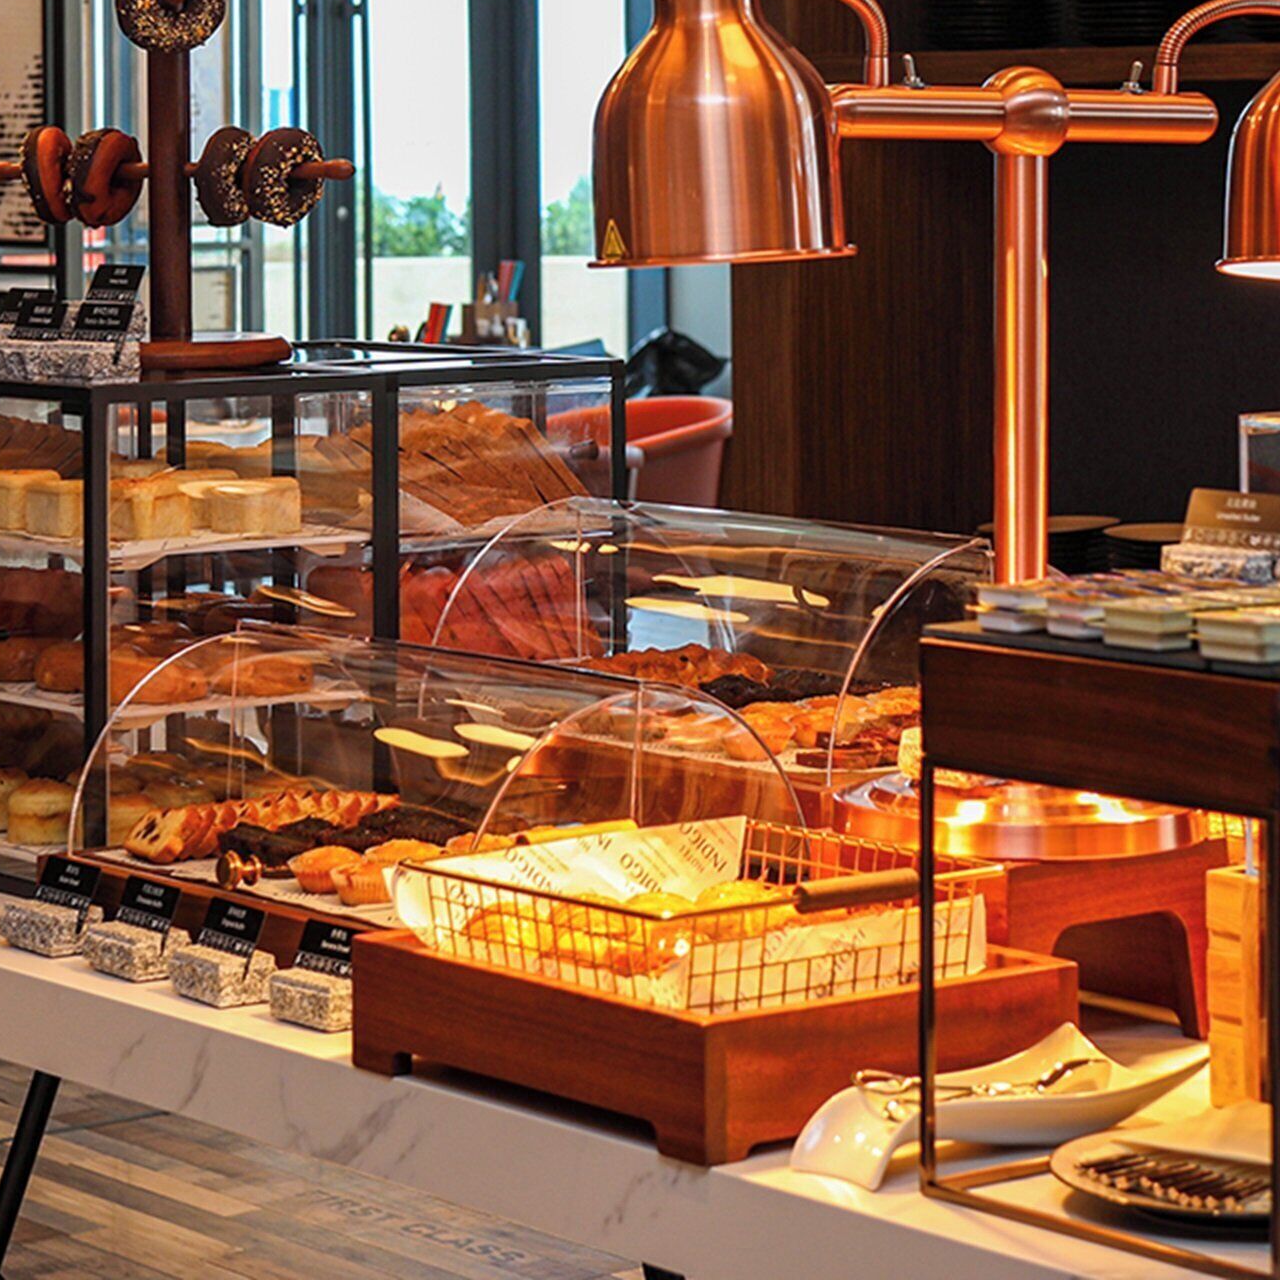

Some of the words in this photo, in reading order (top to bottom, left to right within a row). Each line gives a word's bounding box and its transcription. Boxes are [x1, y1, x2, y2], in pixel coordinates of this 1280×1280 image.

[504, 848, 563, 895] NDIGO
[679, 823, 728, 873] INDIGO
[619, 852, 663, 893] DIGO
